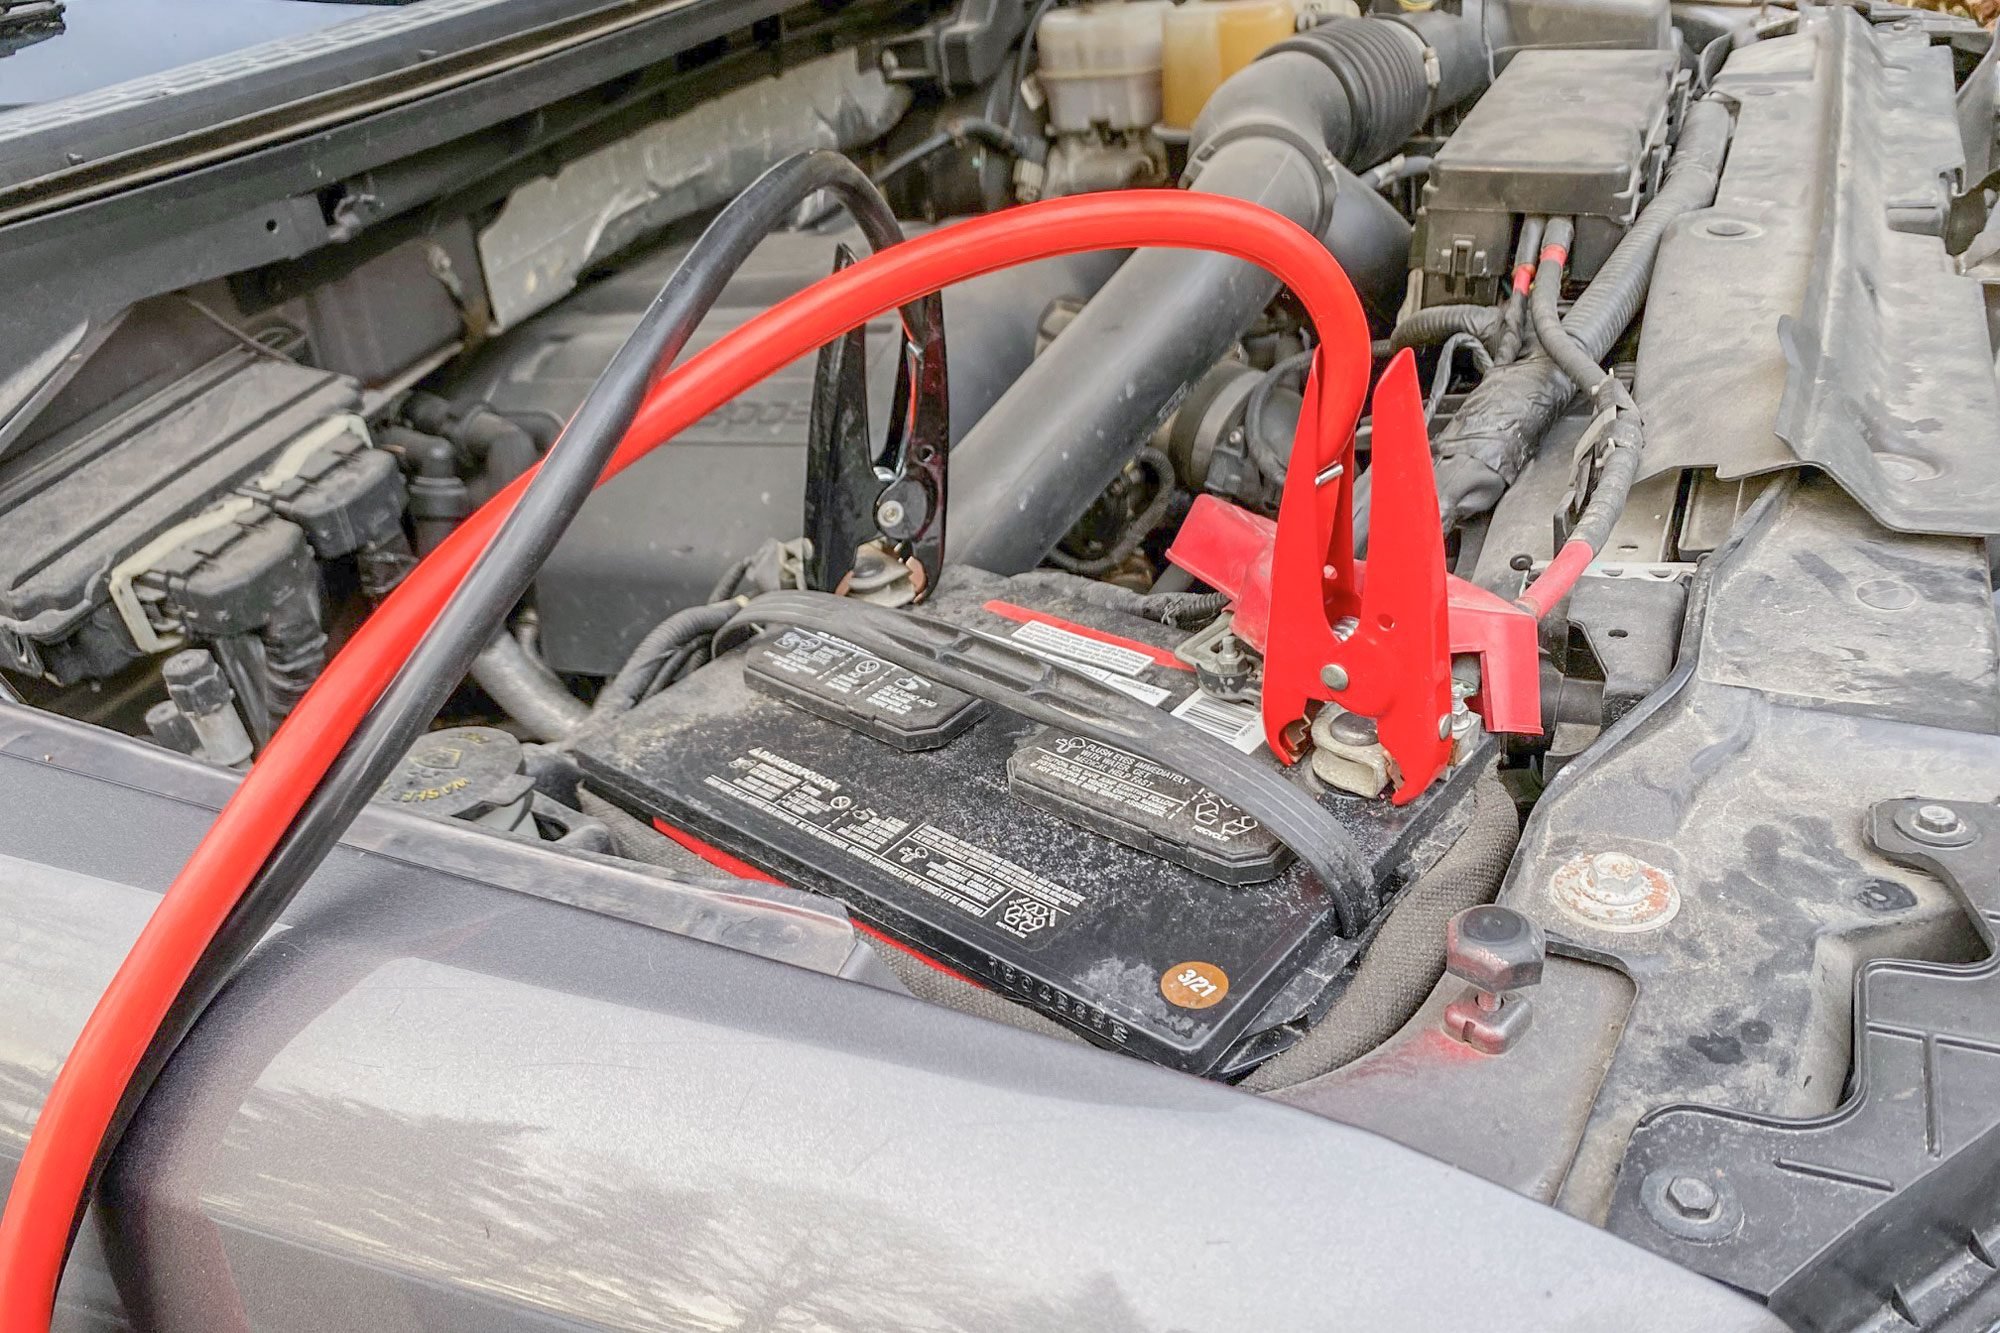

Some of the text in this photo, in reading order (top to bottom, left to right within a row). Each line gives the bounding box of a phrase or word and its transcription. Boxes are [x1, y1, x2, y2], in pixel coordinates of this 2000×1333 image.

[1072, 754, 1155, 788] MEDICAL HELP FAST
[1078, 748, 1103, 761] WITH
[1130, 767, 1152, 779] GET
[1084, 742, 1192, 785] FLUSH EYES IMMEDIATELY
[1115, 781, 1150, 798] STARTING
[1147, 793, 1177, 808] FOLLOW
[1177, 969, 1217, 997] 3/21
